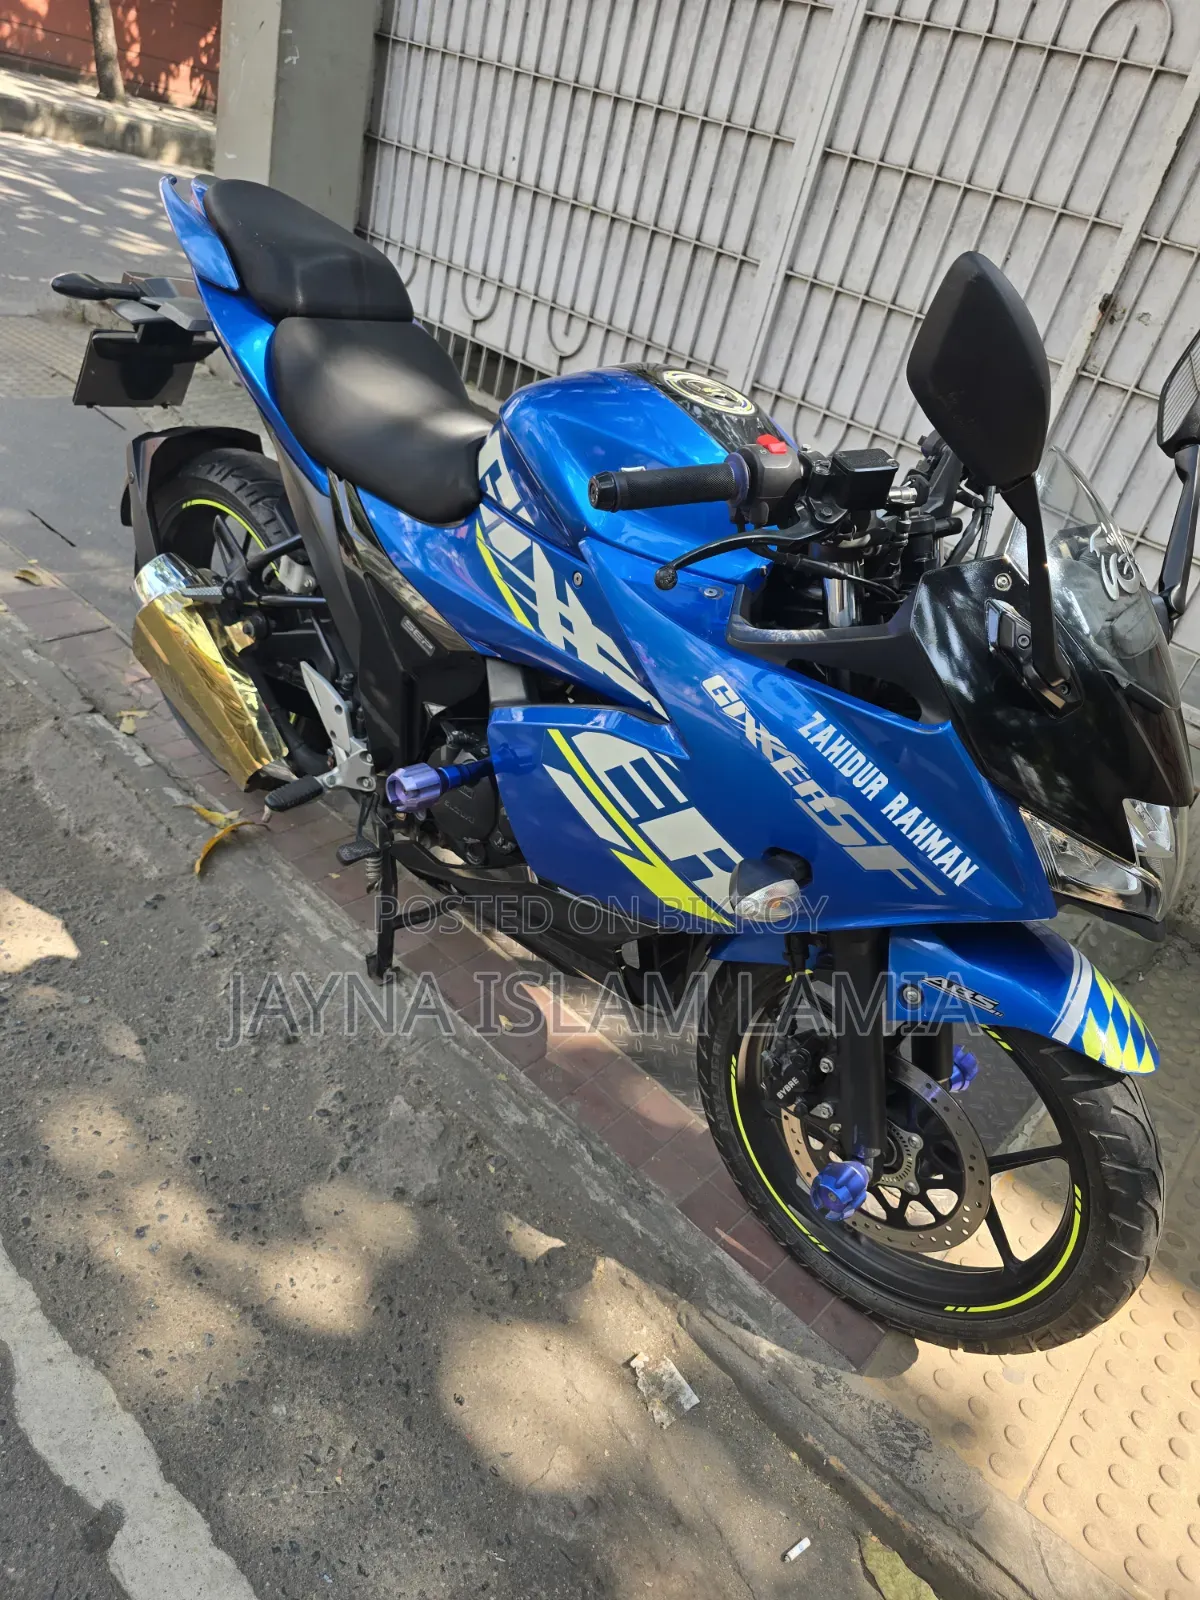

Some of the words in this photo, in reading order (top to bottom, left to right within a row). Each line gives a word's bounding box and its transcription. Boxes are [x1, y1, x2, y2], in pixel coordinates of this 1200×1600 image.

[403, 619, 434, 650] SEP
[702, 674, 836, 813] GIXXER
[797, 711, 889, 802] ZAHIDUR
[880, 791, 980, 887] RAHMAN
[921, 975, 1001, 1010] ABS
[775, 1076, 800, 1101] BYBRE
